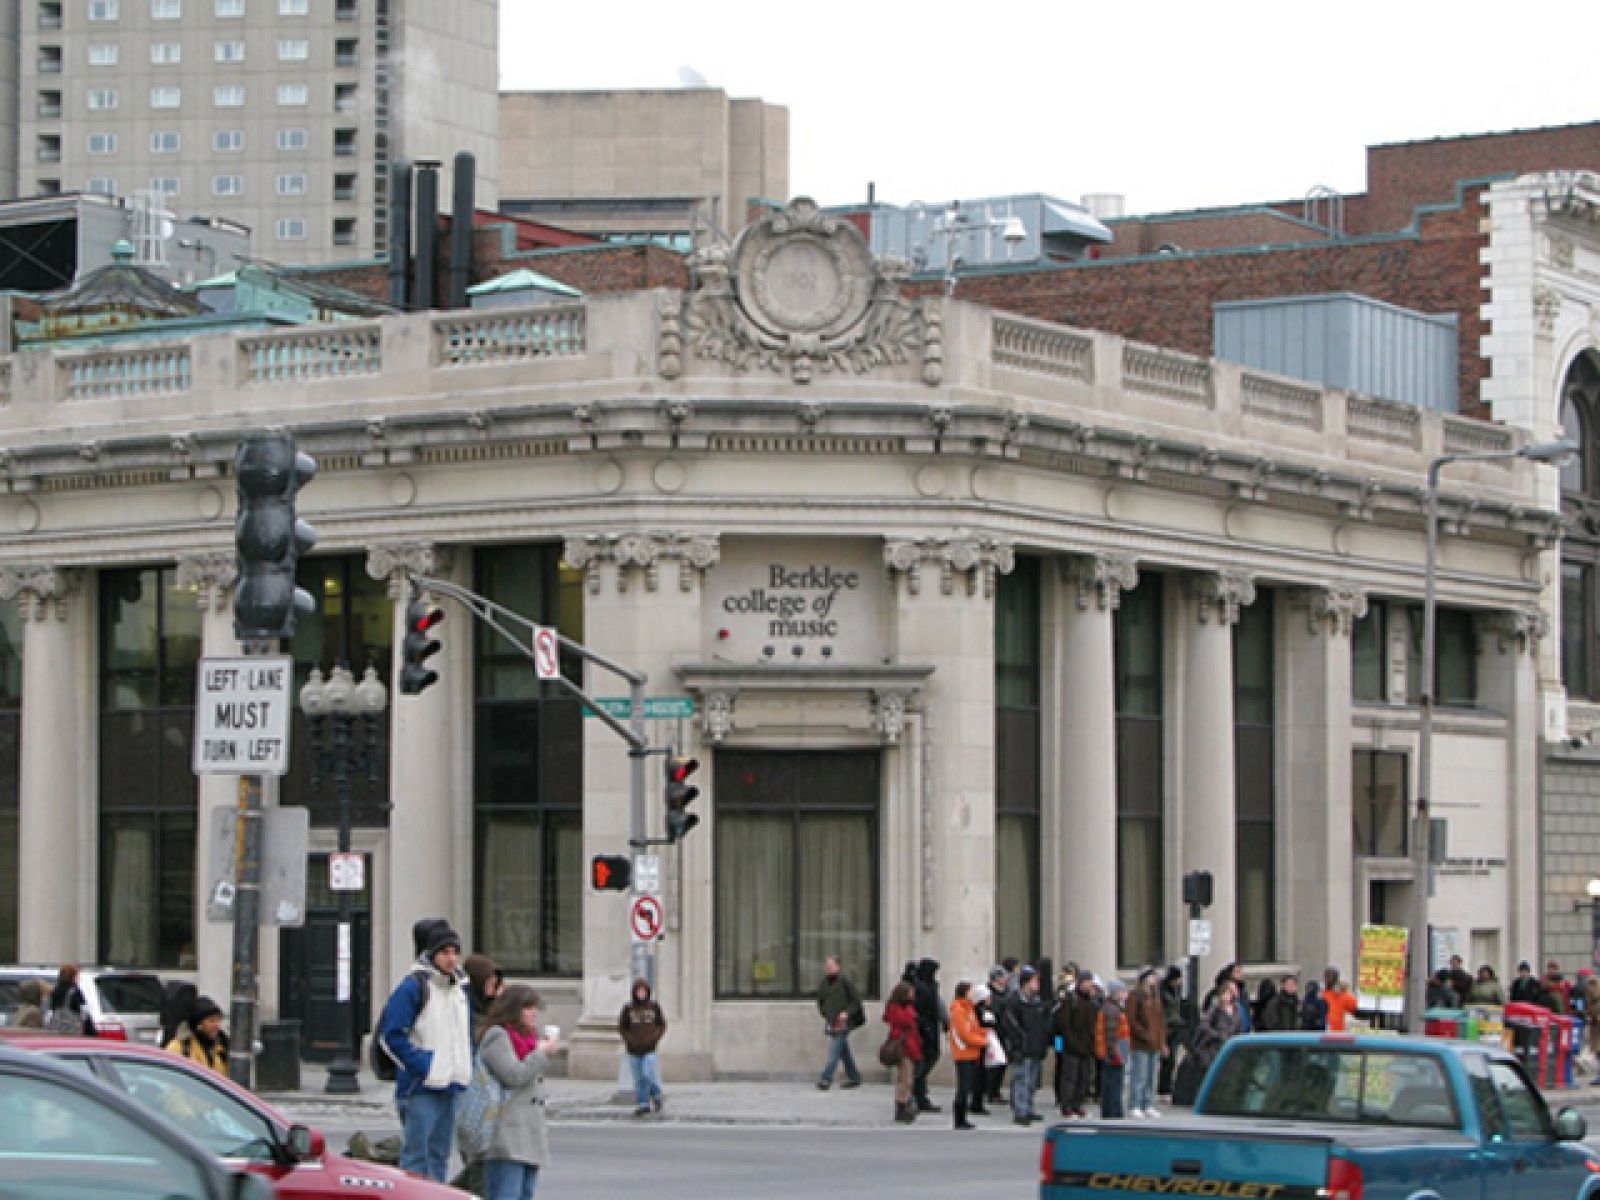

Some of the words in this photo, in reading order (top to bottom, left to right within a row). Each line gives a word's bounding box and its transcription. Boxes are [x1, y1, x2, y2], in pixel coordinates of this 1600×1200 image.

[769, 564, 858, 589] Berklee
[723, 589, 805, 618] college
[812, 587, 840, 618] of
[769, 619, 837, 637] music
[205, 668, 239, 691] LEFT
[248, 667, 283, 690] LANE
[214, 702, 270, 729] MUST
[203, 738, 236, 761] TURN
[248, 738, 281, 761] LEFT
[1088, 1172, 1284, 1199] CHEVROLET
